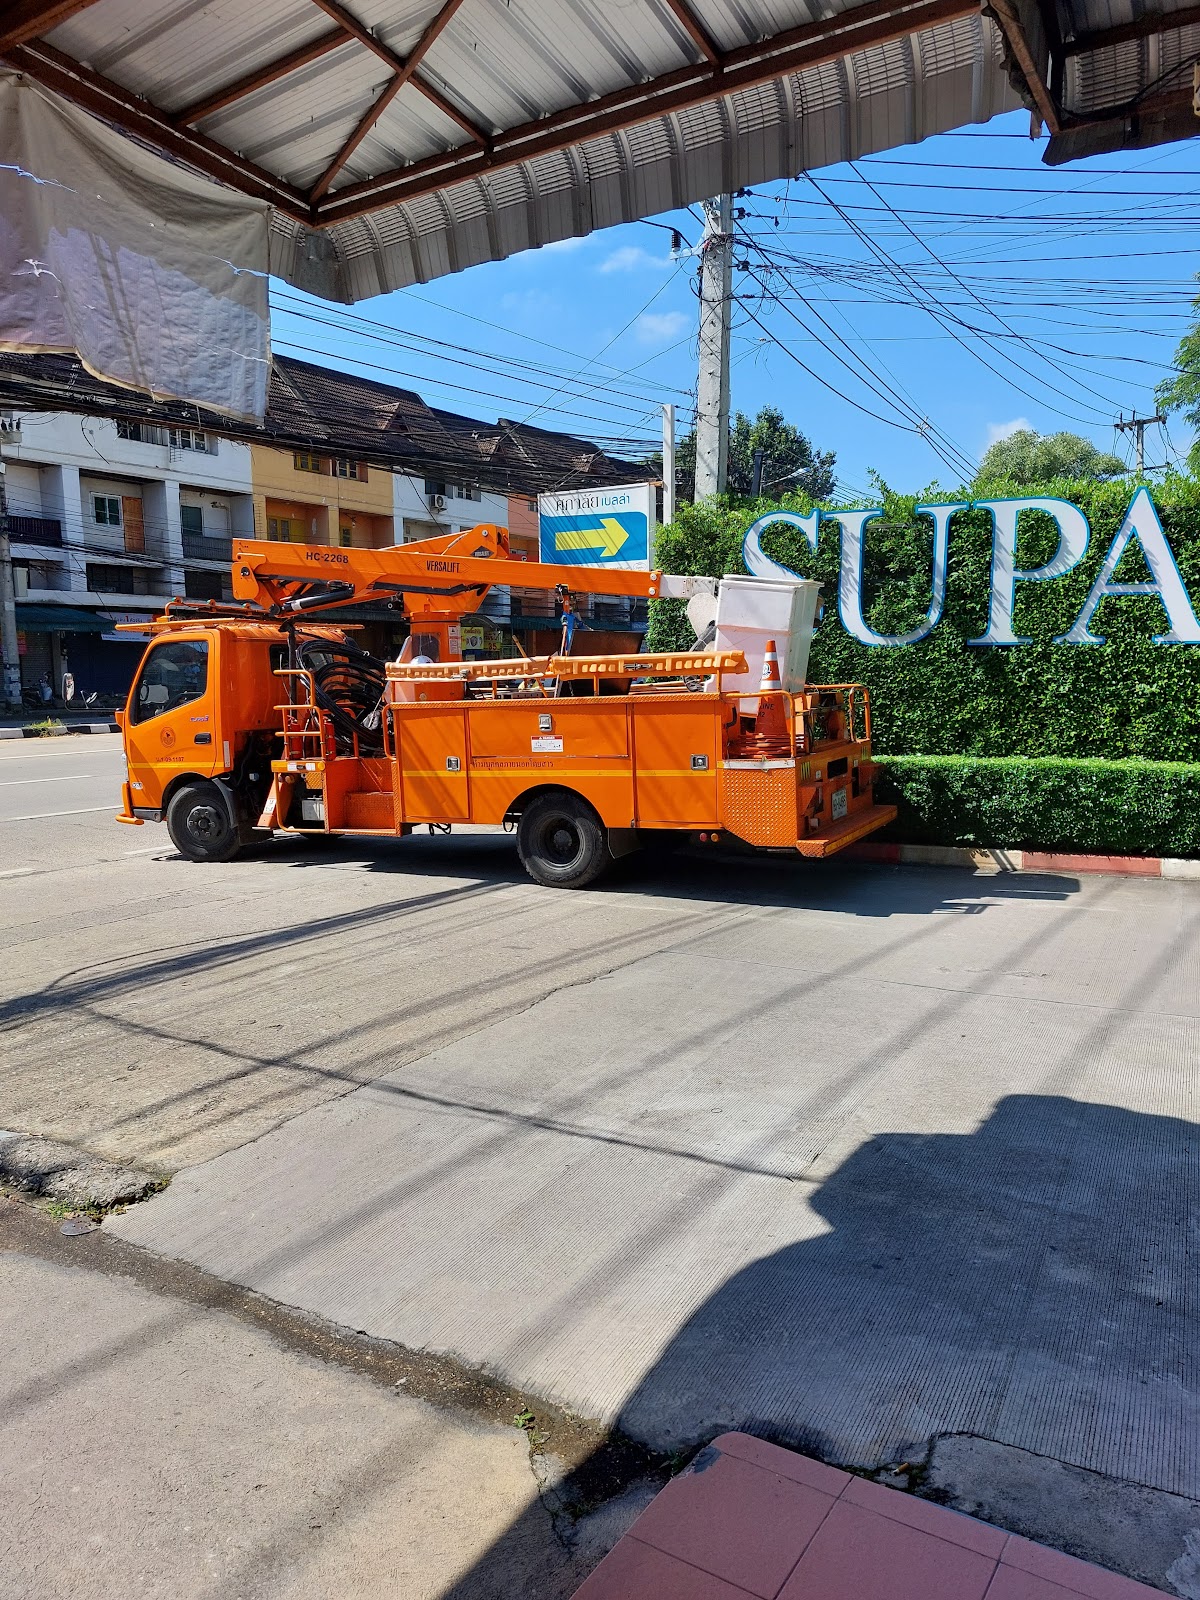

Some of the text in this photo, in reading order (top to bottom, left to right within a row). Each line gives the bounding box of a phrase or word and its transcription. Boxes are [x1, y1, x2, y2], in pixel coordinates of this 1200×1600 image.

[601, 493, 630, 506] เบลล่า
[306, 552, 349, 564] HC-2268
[426, 560, 460, 573] VERSALIFT
